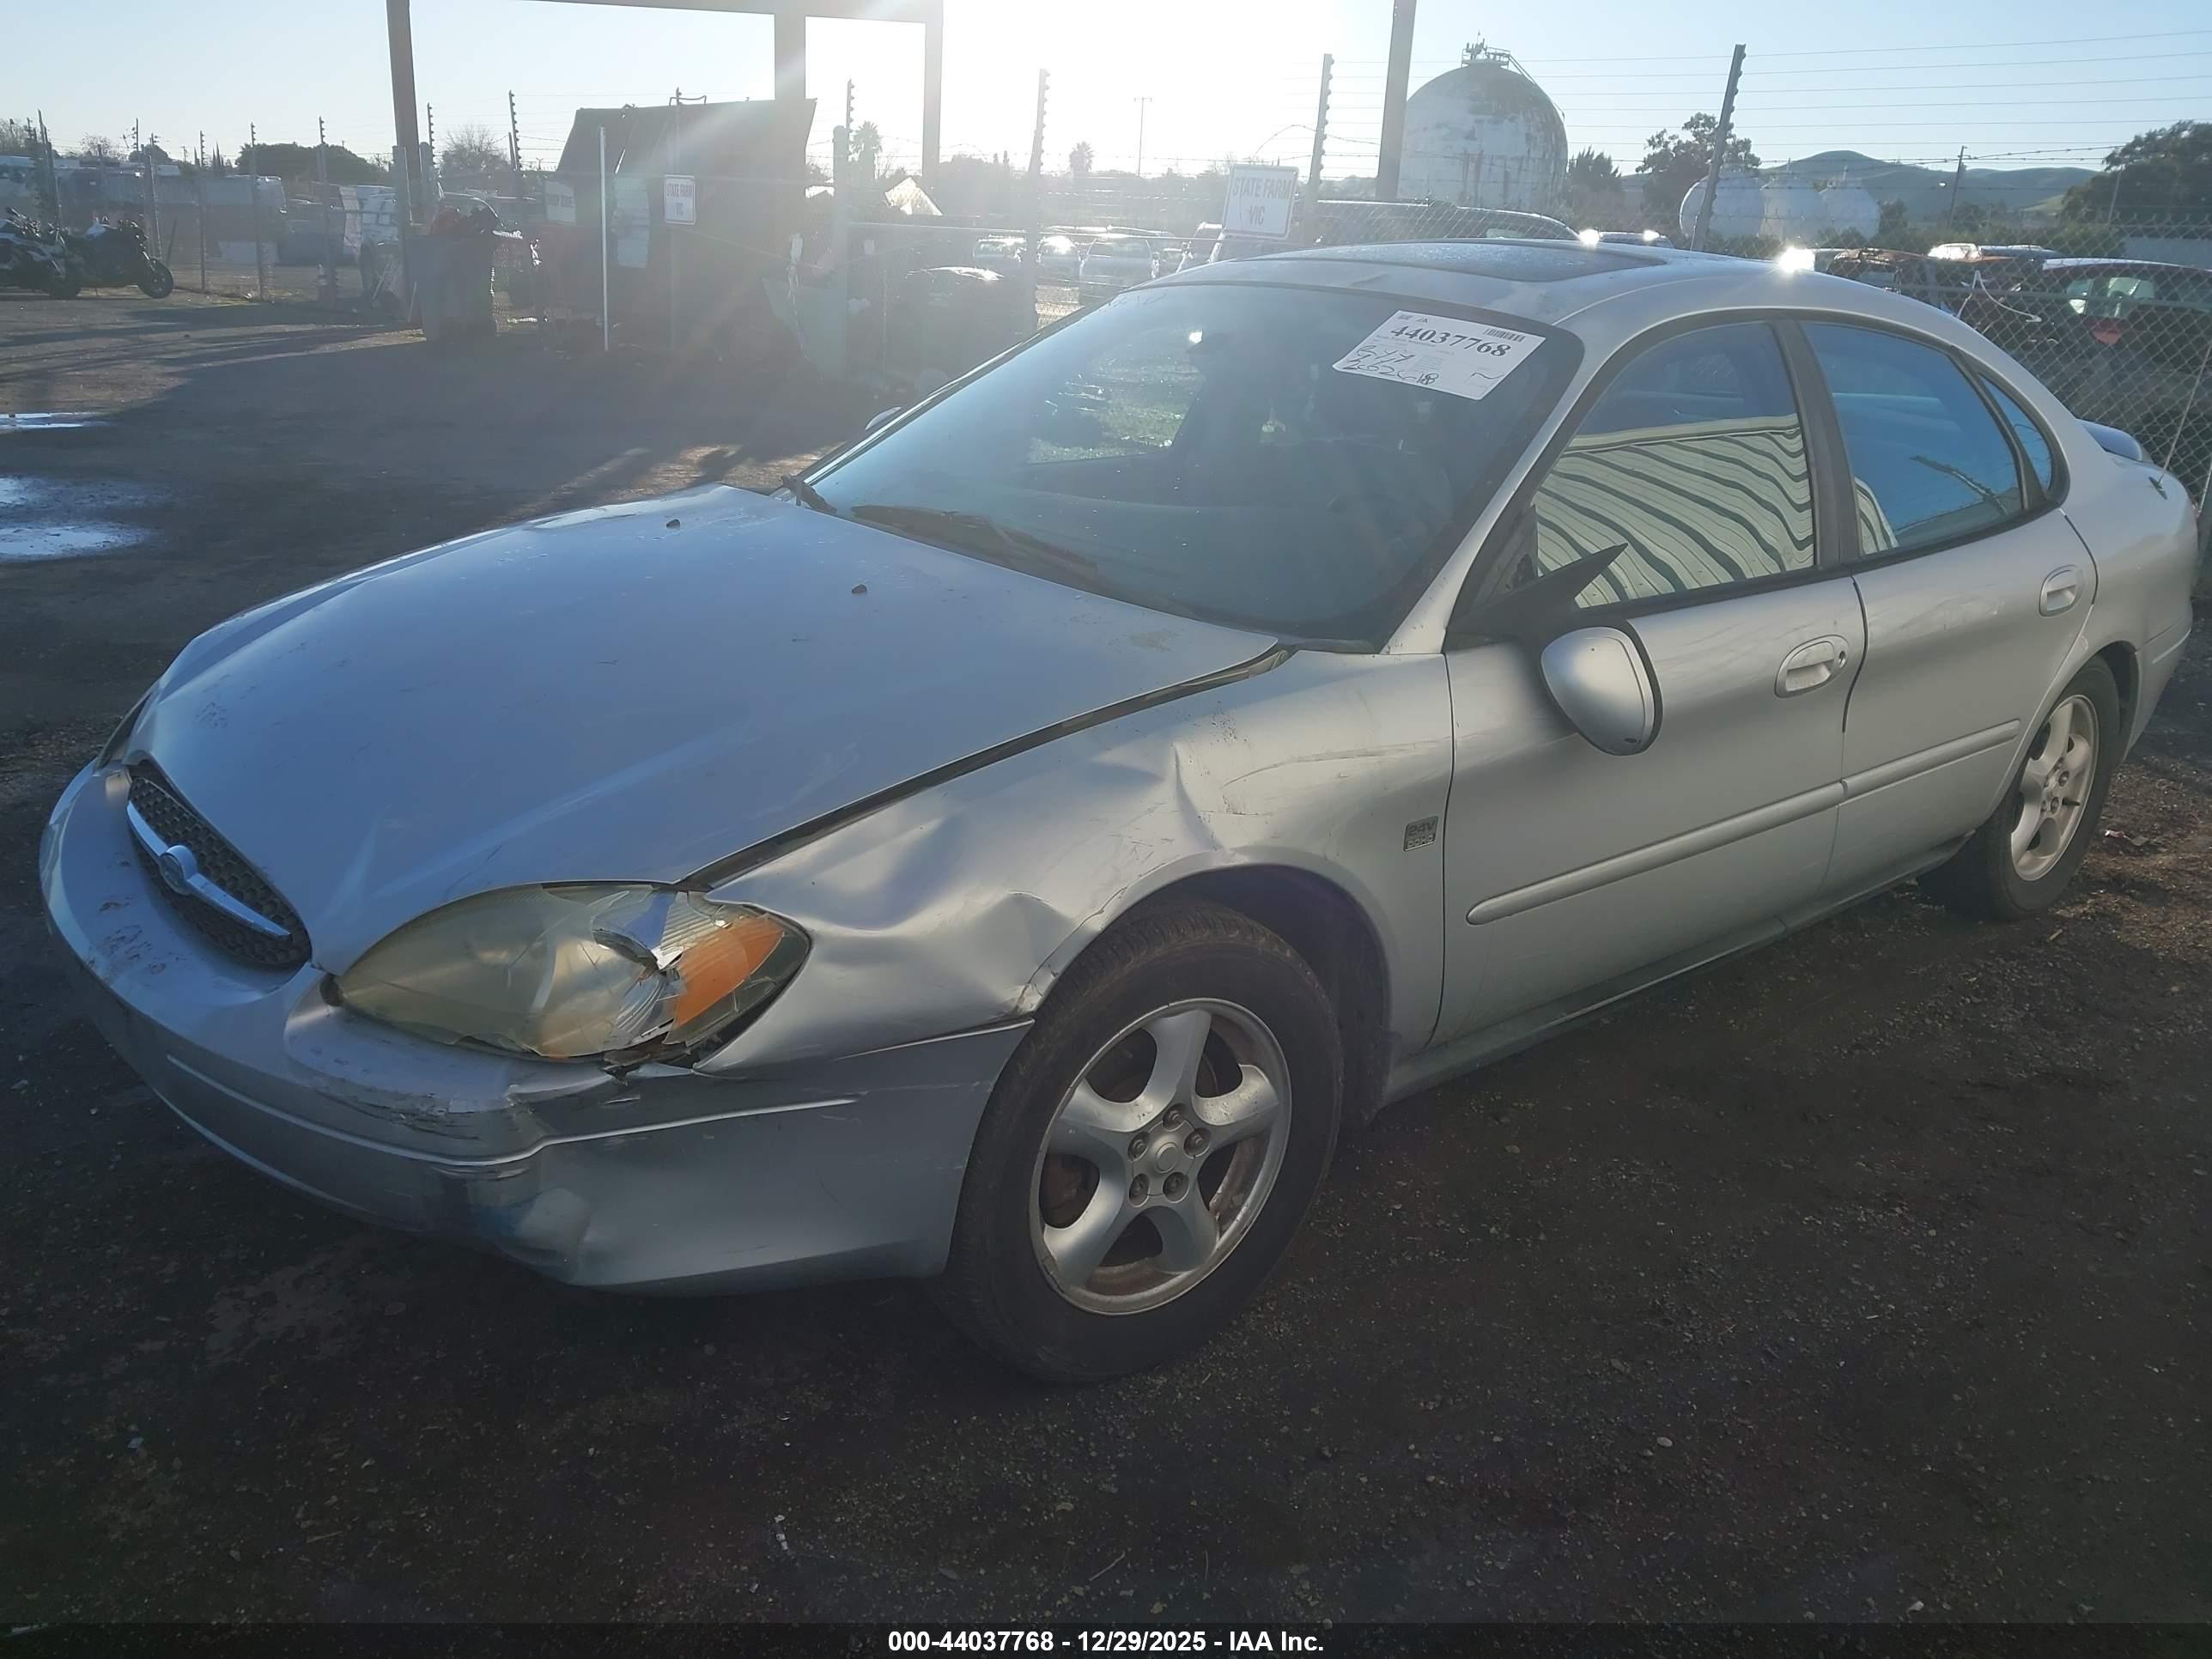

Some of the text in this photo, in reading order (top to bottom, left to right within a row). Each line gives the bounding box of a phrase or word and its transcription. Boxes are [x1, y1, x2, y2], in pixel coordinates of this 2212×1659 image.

[1233, 176, 1292, 200] STATE FARM
[1249, 205, 1266, 226] VIC
[1390, 325, 1512, 358] 44037768
